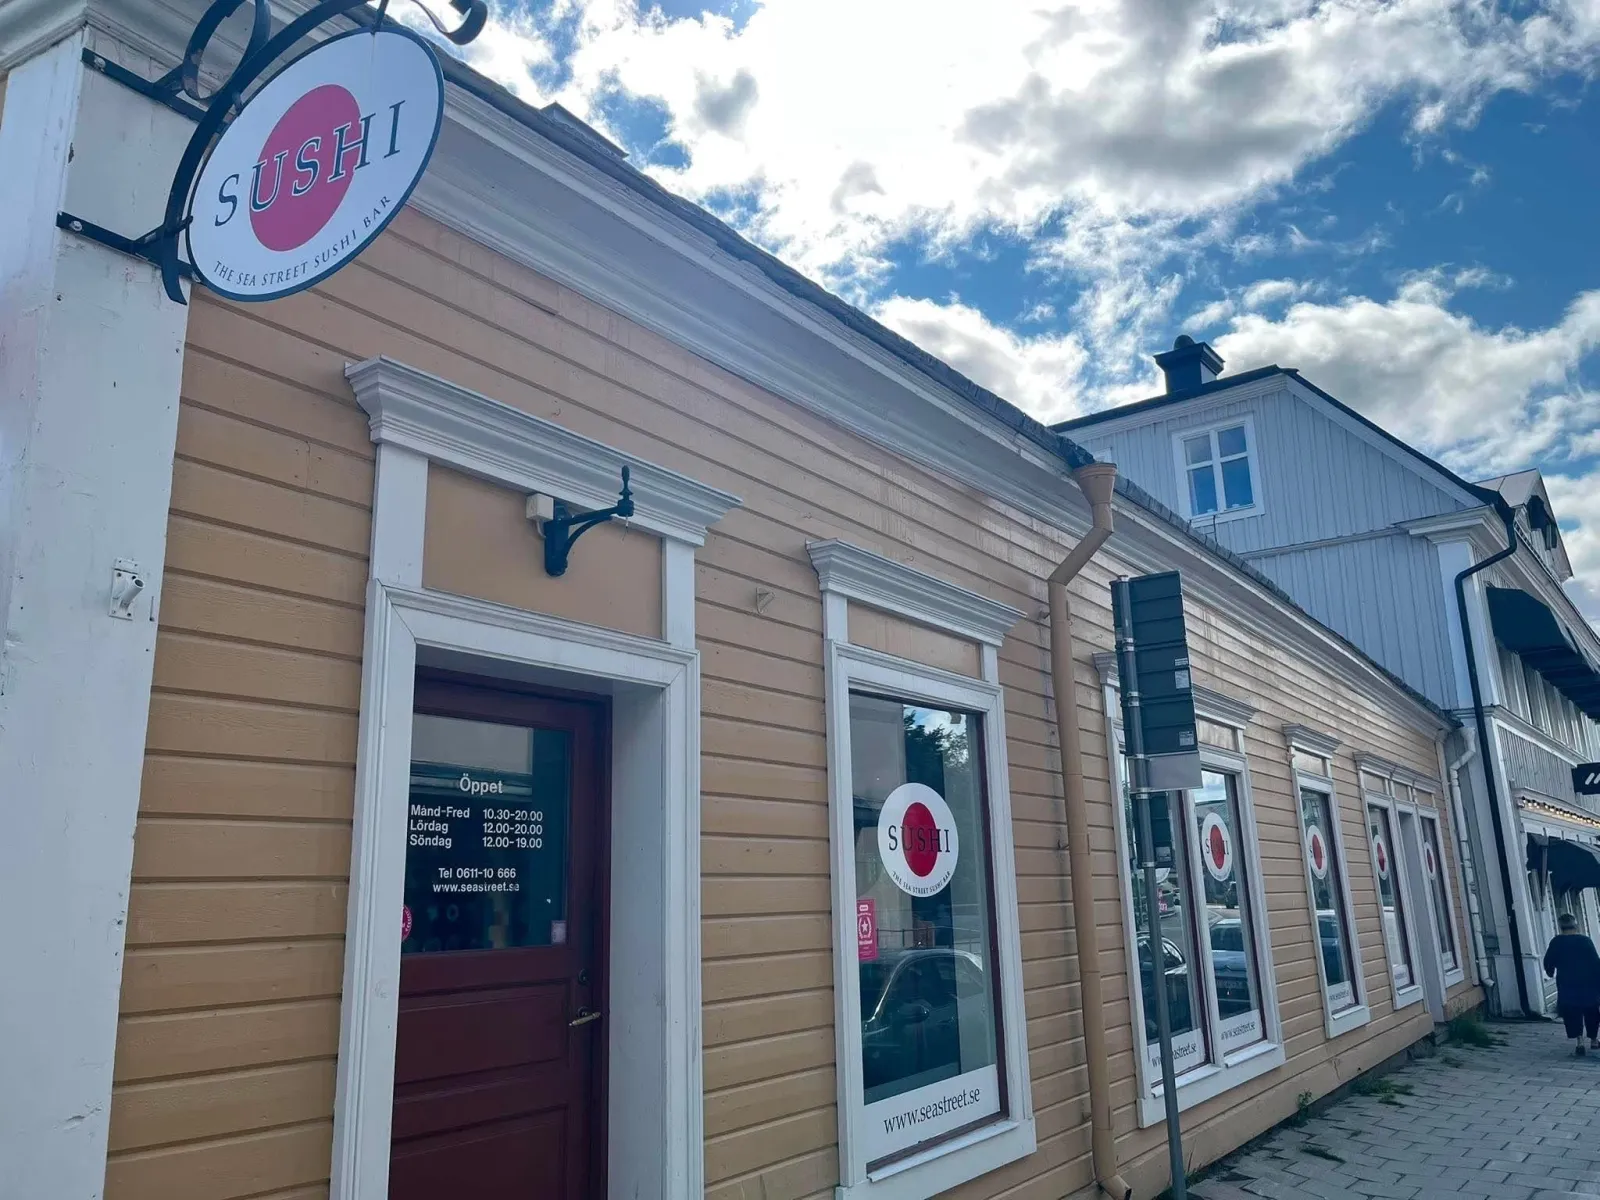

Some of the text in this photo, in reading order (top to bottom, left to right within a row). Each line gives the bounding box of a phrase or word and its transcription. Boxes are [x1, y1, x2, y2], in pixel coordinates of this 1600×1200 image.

[214, 100, 406, 227] SUSHI
[213, 195, 391, 286] THE SEA STREET SUSHI BAR
[459, 773, 503, 795] Öppet
[410, 804, 543, 822] Månd-Fred 10.30-20.00
[410, 819, 543, 835] Lördag 12.00-20.00
[409, 834, 543, 849] Söndag 12.00-19.00
[888, 824, 951, 853] SUSHI
[438, 867, 516, 878] Tel 0611-10 666
[432, 881, 520, 893] www.seastreet.se
[883, 1088, 980, 1134] www.seastreet.se
